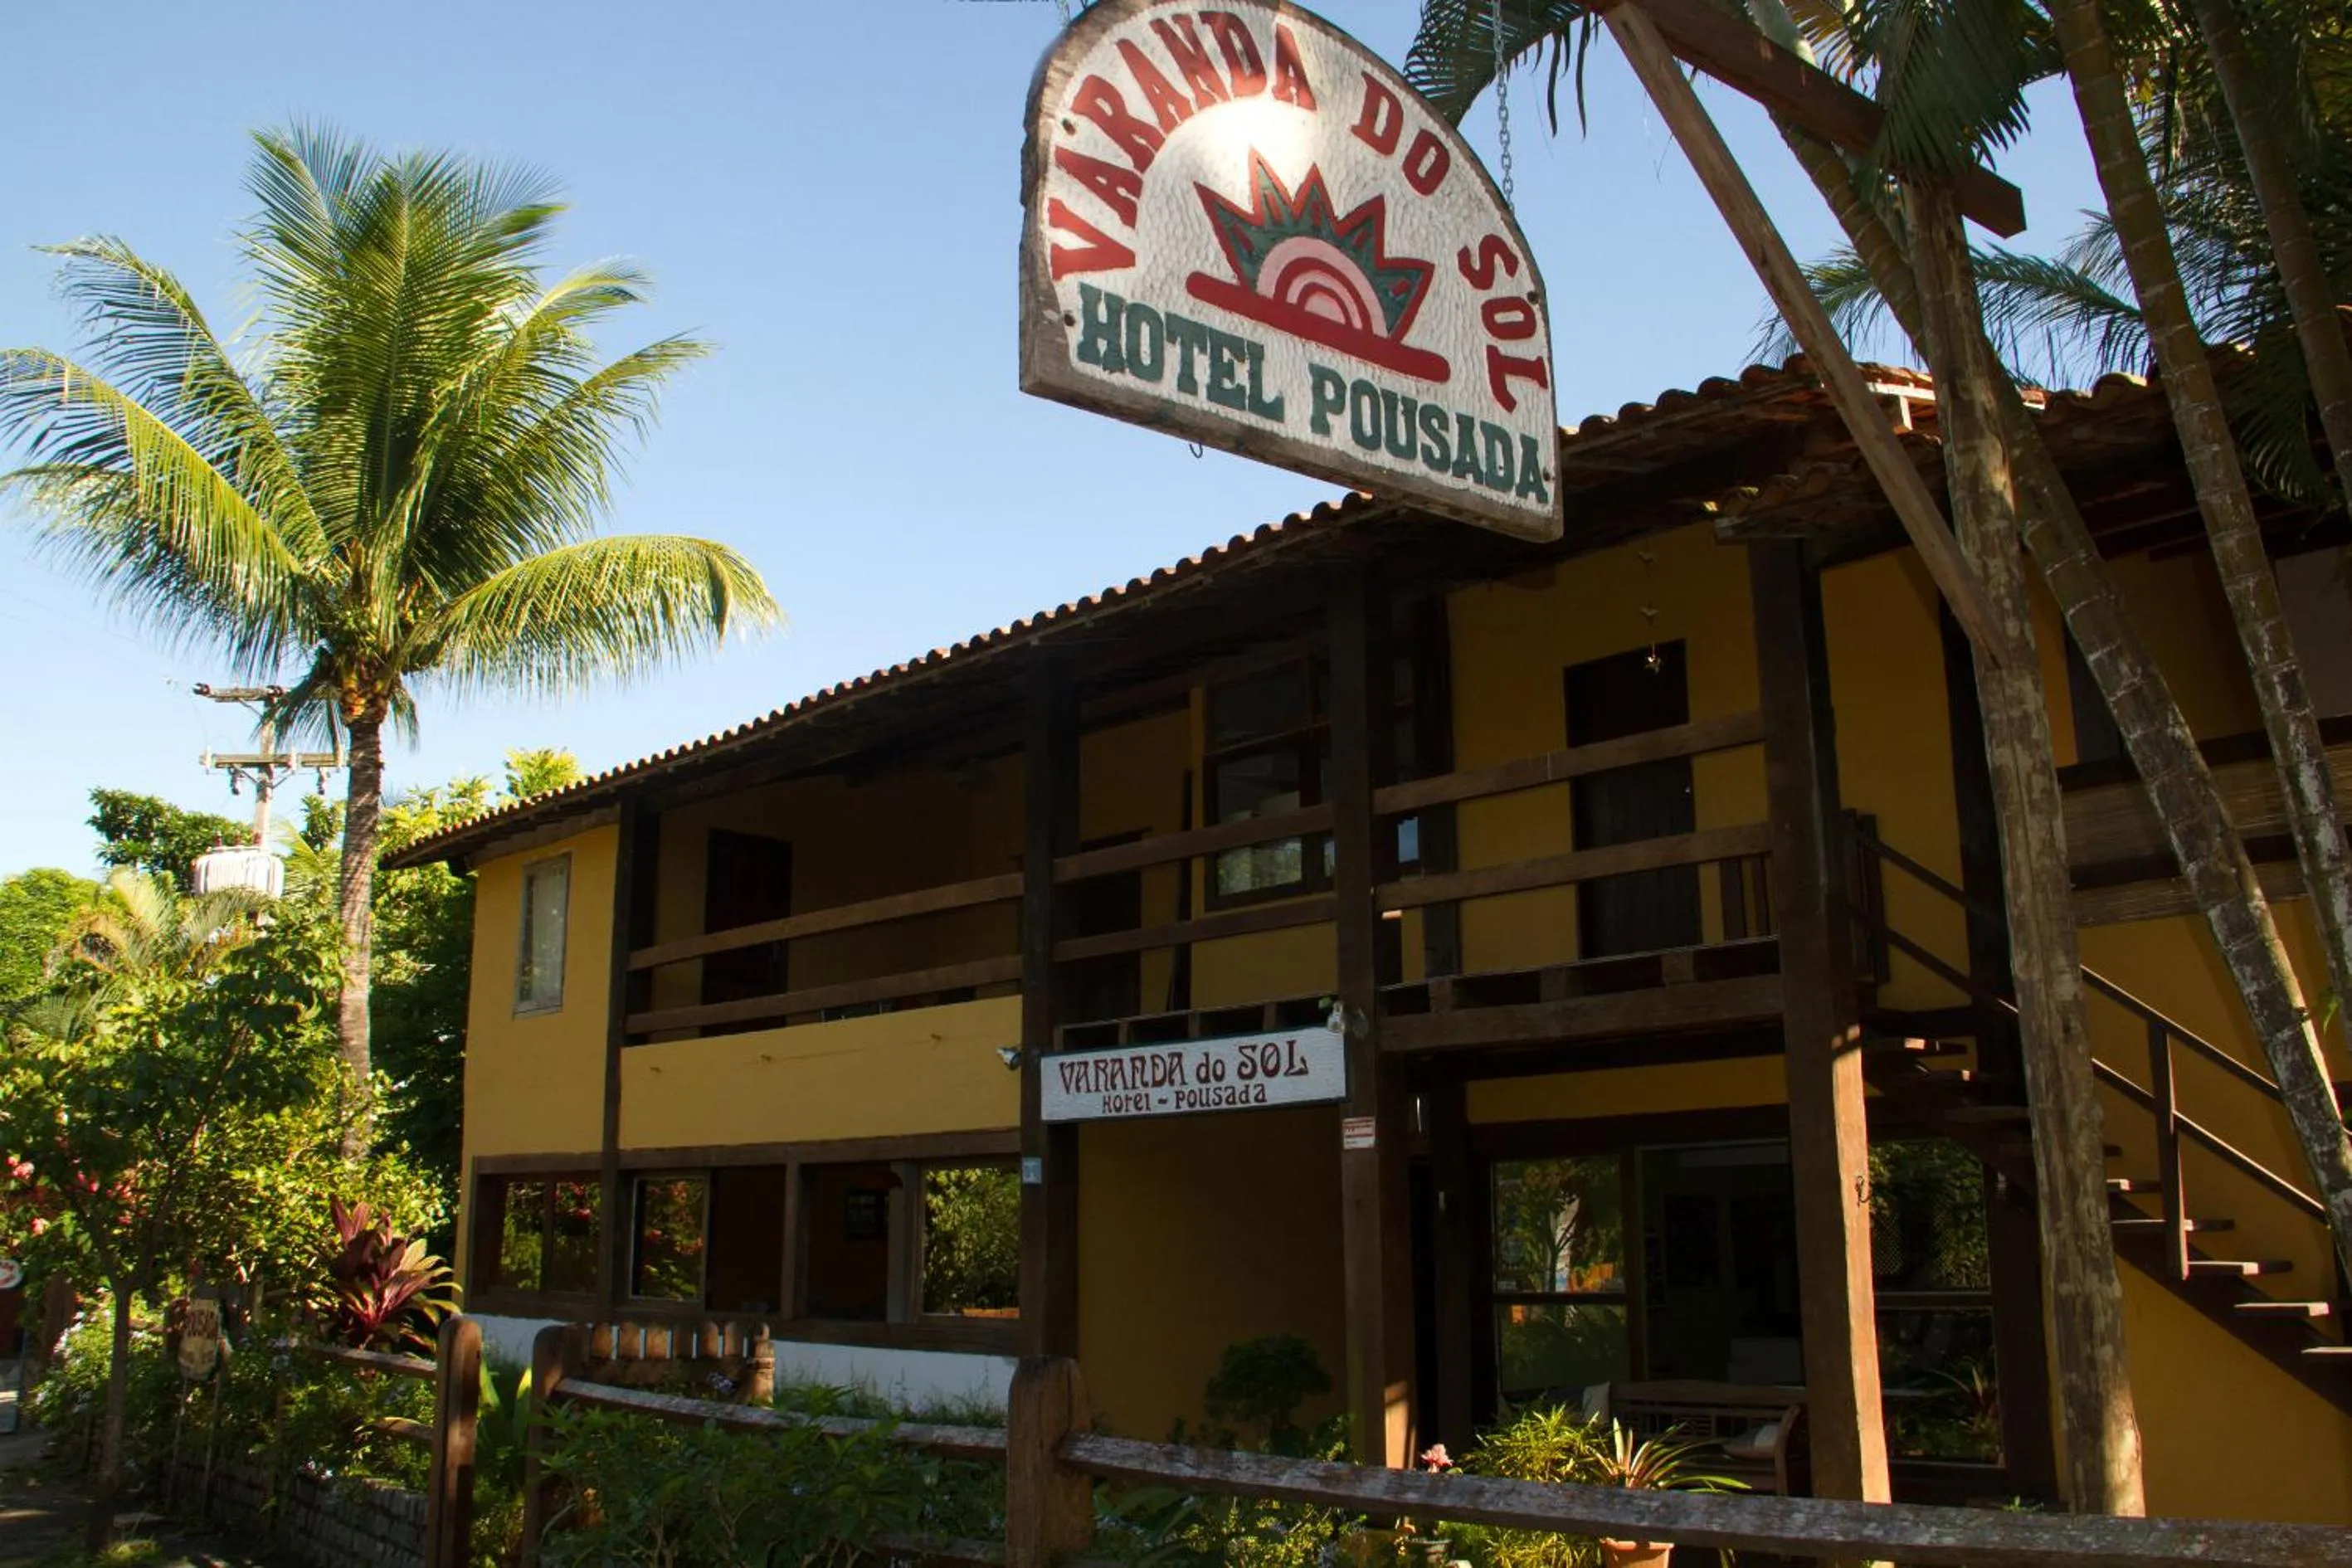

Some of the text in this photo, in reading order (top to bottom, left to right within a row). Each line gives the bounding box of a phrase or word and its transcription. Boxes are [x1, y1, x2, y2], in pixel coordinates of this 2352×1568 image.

[1047, 10, 1550, 413] VARANDA DO SOL
[1077, 280, 1550, 504] HOTEL POUSADA
[1059, 1040, 1308, 1094] VARANDA do SOL
